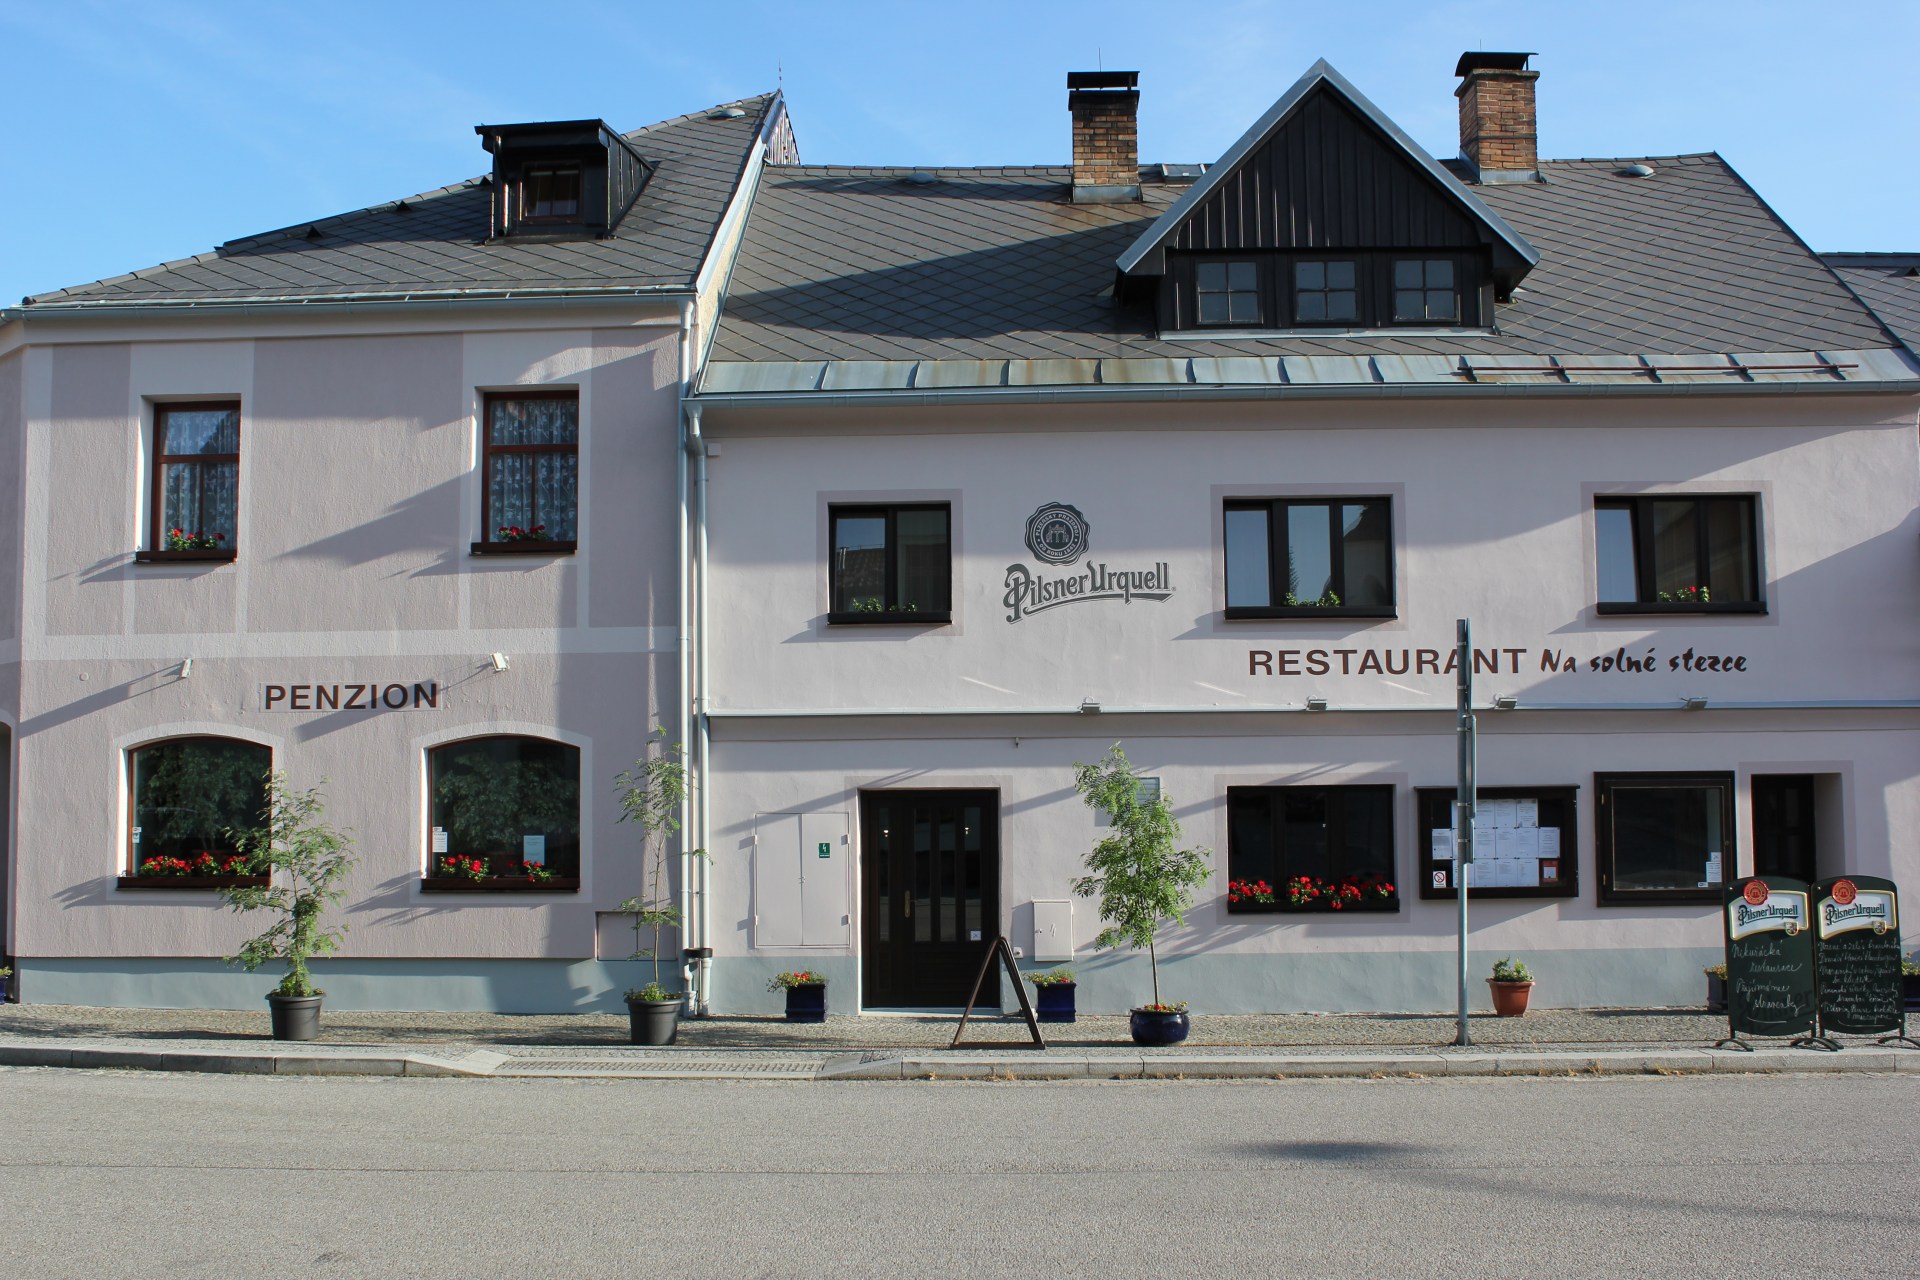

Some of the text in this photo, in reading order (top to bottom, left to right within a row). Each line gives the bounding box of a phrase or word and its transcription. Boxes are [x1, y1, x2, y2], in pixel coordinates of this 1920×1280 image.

[1039, 543, 1047, 552] OD
[1002, 560, 1170, 625] Pilsner Urquell
[1248, 647, 1748, 677] RESTAURANT Na solné stezce
[264, 682, 440, 711] PENZION
[1737, 904, 1799, 927] Pilsner Urquell
[1825, 903, 1886, 926] Pilsner Urquell
